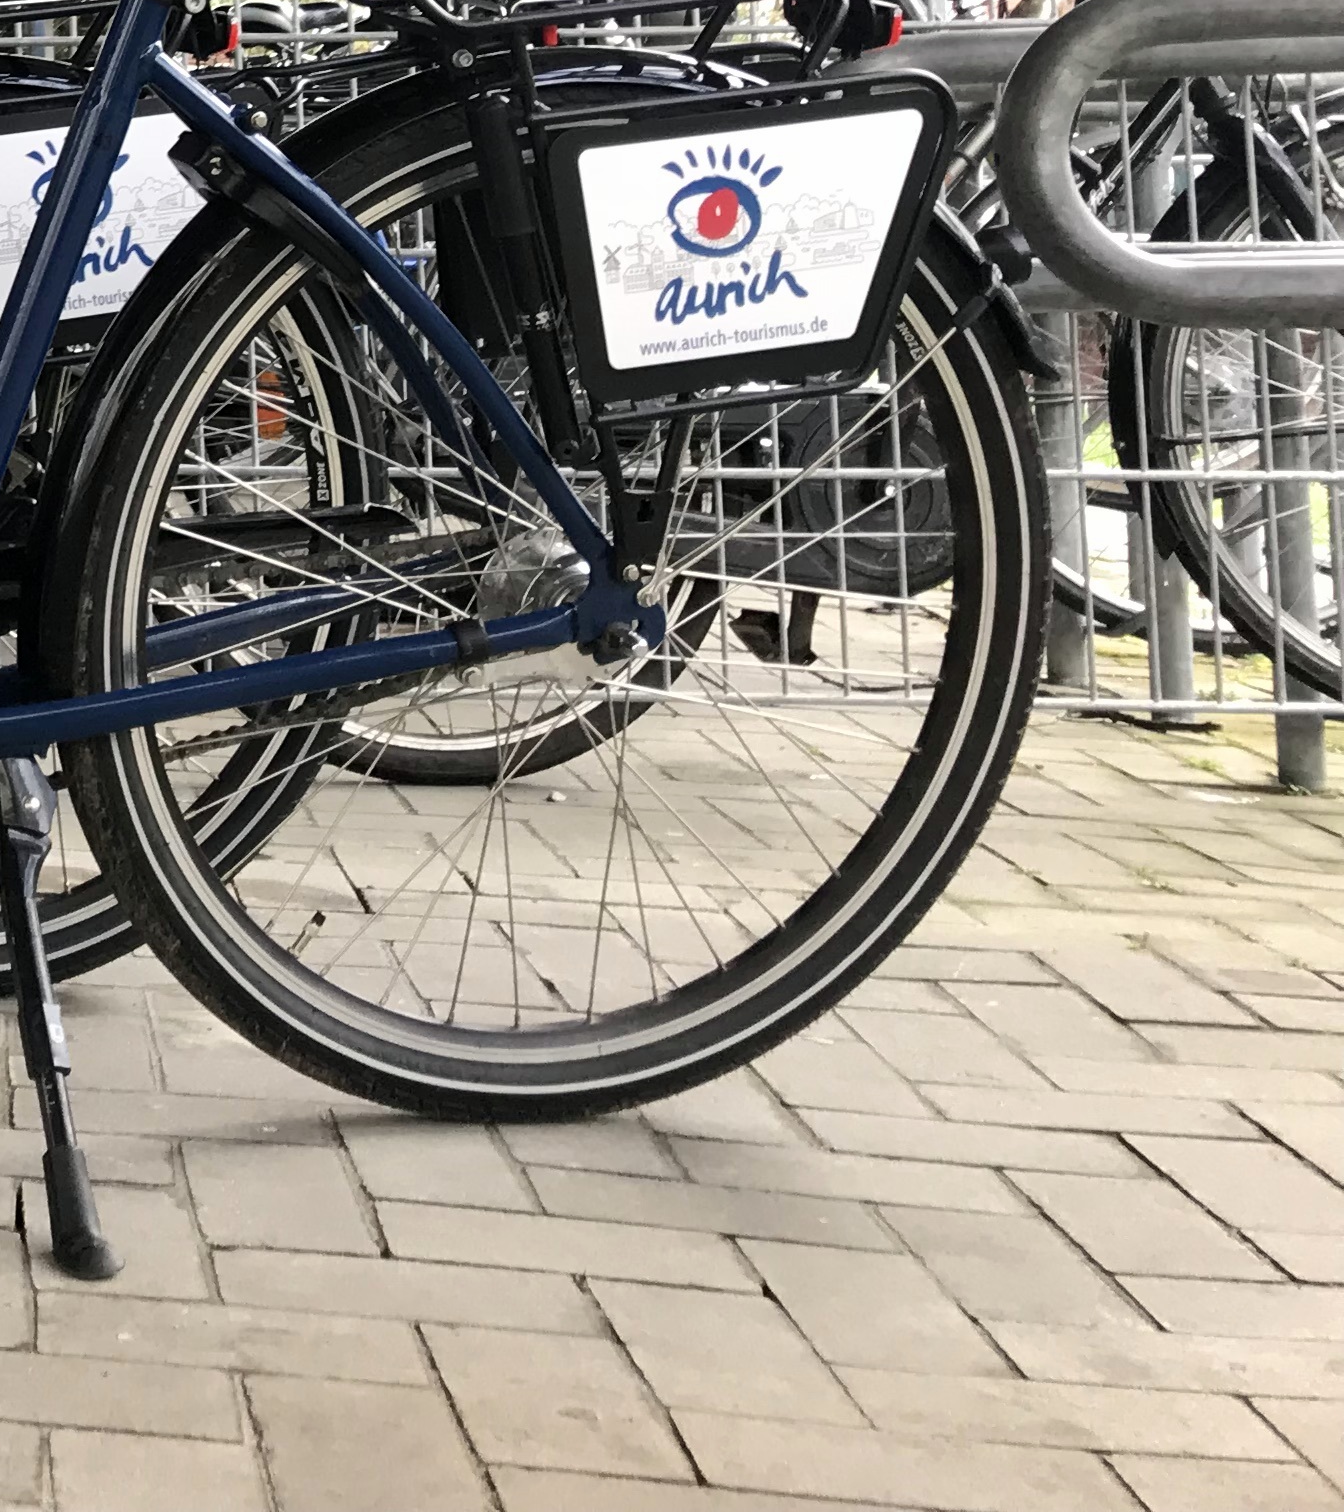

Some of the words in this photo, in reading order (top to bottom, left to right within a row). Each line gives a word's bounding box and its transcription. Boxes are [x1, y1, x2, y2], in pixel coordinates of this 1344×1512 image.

[70, 225, 155, 286] rich
[654, 249, 809, 325] aurich
[639, 316, 829, 357] www.aurich-tourismus.de
